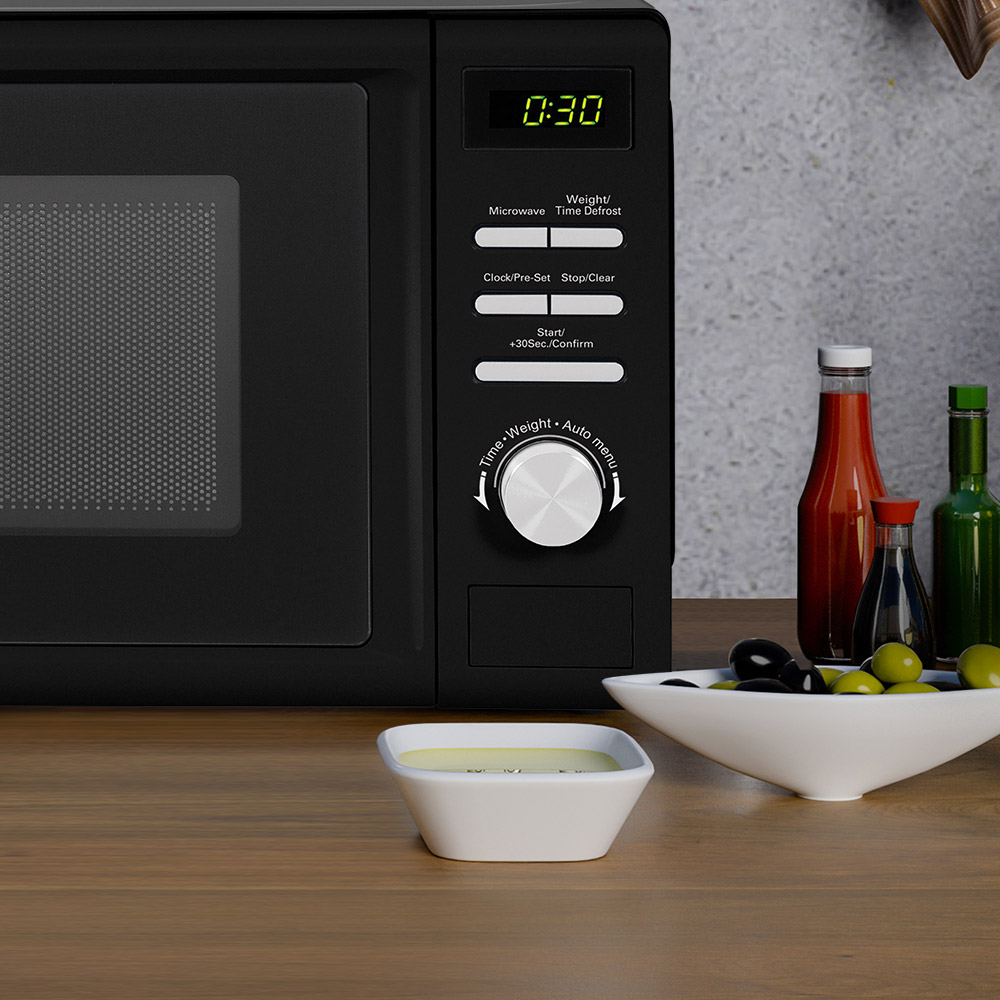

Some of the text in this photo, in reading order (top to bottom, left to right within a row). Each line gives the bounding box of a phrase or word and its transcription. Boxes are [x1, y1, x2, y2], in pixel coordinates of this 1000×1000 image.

[523, 95, 603, 126] 0:30
[566, 194, 611, 206] Weight/
[488, 206, 546, 216] Microwave
[555, 205, 622, 216] Time Defrost
[483, 272, 551, 283] Clock/Pre-Set
[561, 272, 616, 284] Stop/Clear
[536, 327, 565, 337] Start/
[509, 338, 594, 349] +30Sec./Confirm
[479, 418, 618, 469] Time Weight Auto menu
